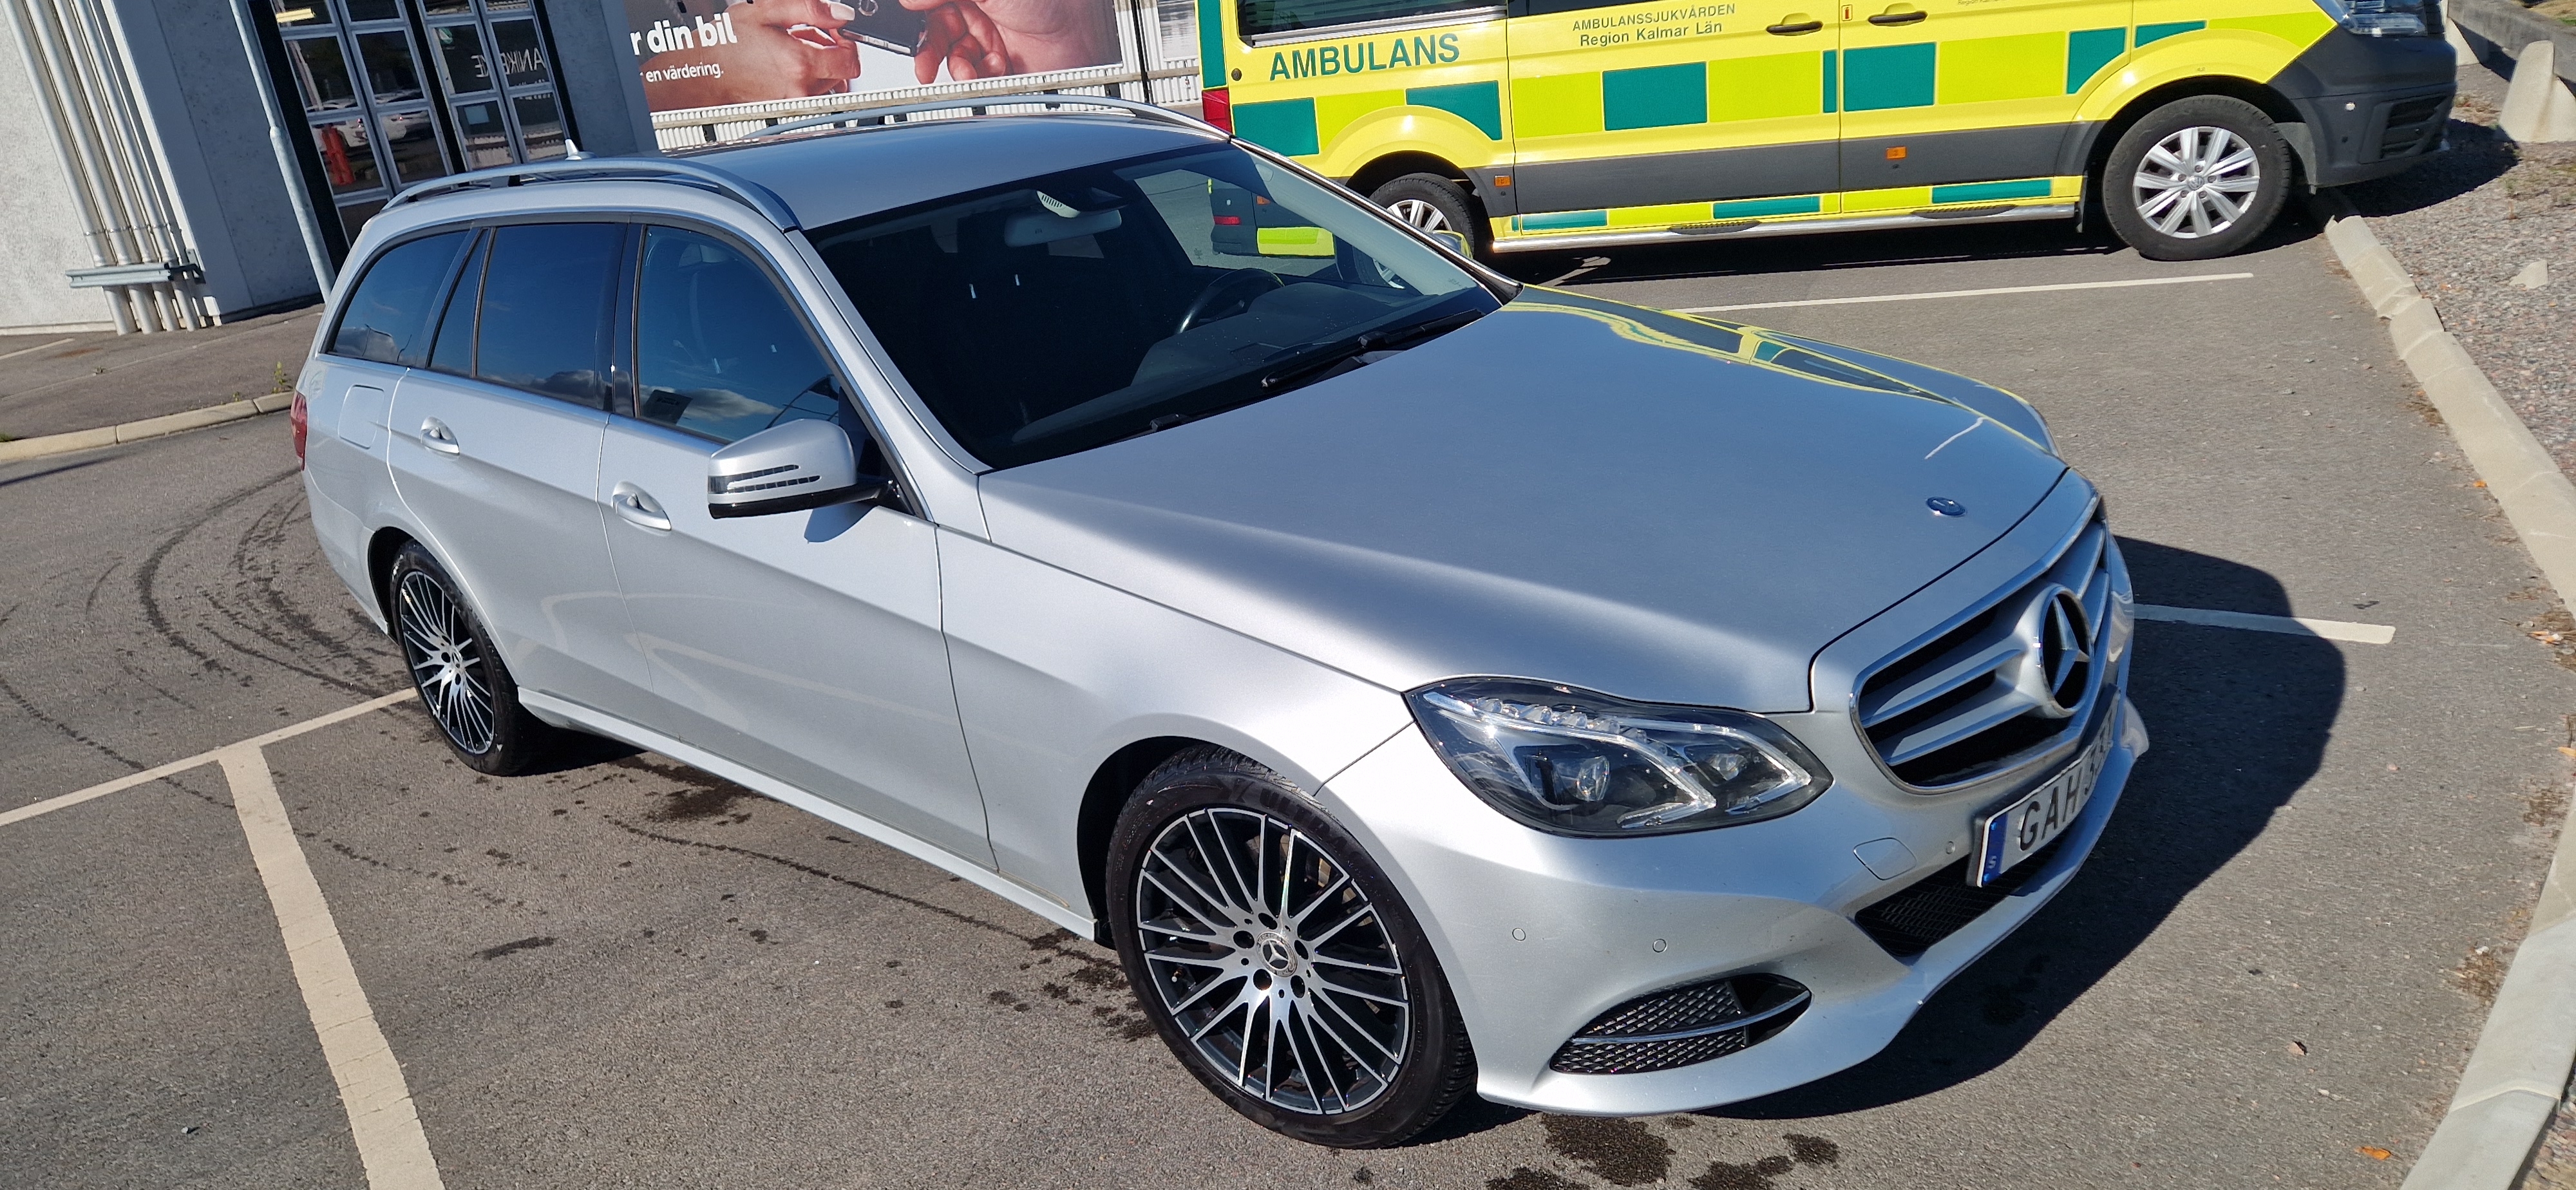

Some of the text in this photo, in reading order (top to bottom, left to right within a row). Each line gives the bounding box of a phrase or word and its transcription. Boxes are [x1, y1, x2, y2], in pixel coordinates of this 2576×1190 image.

[1573, 3, 1736, 31] AMBULANSSJUKVÅRDEN
[647, 19, 694, 53] din
[695, 12, 738, 47] bil
[1580, 20, 1722, 47] Region Kalmar Län
[1269, 33, 1460, 81] AMBULANS
[645, 61, 724, 82] en värdering.
[2020, 767, 2083, 851] GAH
[1987, 855, 1997, 869] S
